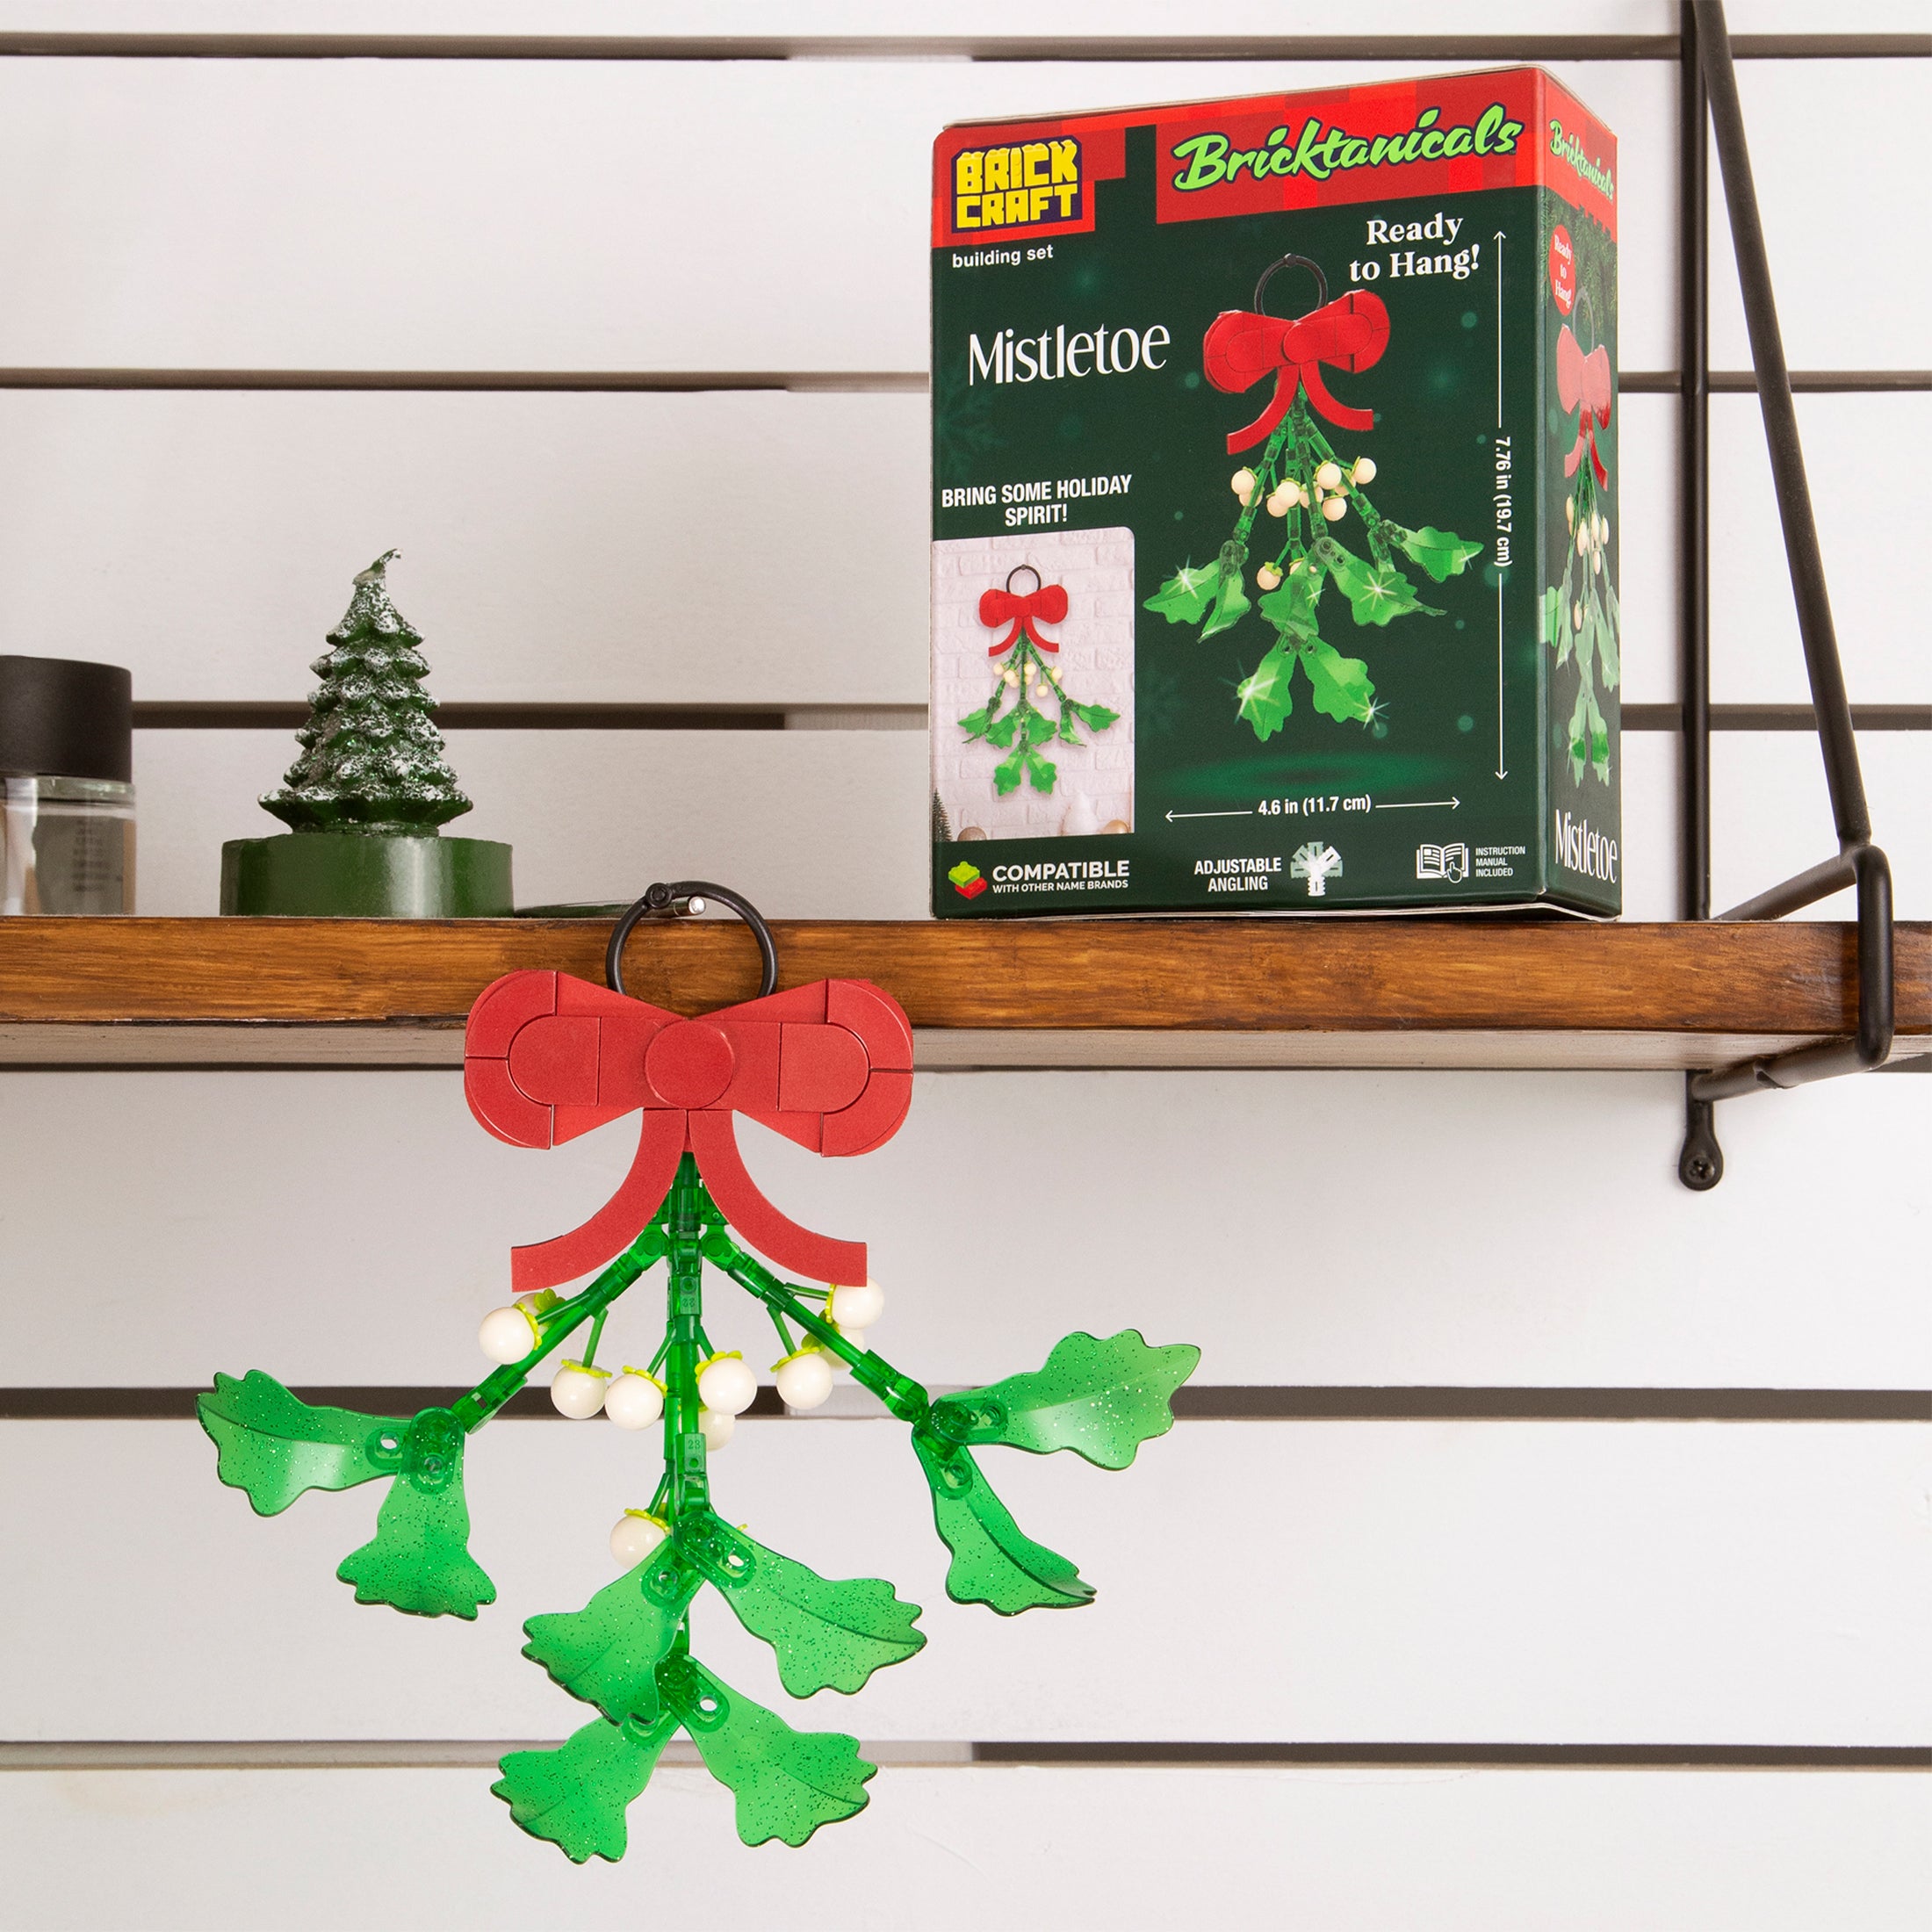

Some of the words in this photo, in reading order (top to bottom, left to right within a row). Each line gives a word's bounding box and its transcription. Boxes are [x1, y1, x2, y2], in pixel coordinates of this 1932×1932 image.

[1173, 104, 1524, 190] Bricktanicals
[1549, 119, 1615, 202] Bricktanicals
[956, 139, 1078, 195] BRICK
[956, 184, 1078, 228] CRAFT
[1366, 212, 1464, 247] Ready
[951, 249, 1021, 268] building
[1026, 243, 1054, 261] set
[1349, 256, 1381, 282] to
[1388, 244, 1481, 280] Hang!
[1554, 234, 1573, 265] Ready
[969, 323, 1171, 386] Mistletoe
[1495, 436, 1511, 472] 7.76
[941, 483, 997, 508] BRING
[1000, 479, 1053, 504] SOME
[1056, 473, 1132, 500] HOLIDAY
[1495, 473, 1510, 491] in
[1004, 503, 1068, 527] SPIRIT!
[1493, 494, 1512, 534] (19.7
[1493, 536, 1512, 567] cm)
[1258, 799, 1281, 816] 4.6
[1284, 798, 1299, 815] in
[1302, 796, 1339, 817] (11.7
[1343, 793, 1372, 813] cm)
[1475, 846, 1526, 856] INSTRUCTION
[1554, 808, 1618, 884] Mistletoe
[991, 859, 1130, 883] COMPATIBLE
[1193, 857, 1282, 876] ADJUSTABLE
[1475, 857, 1508, 867] MANUAL
[1475, 867, 1514, 877] INCLUDED
[992, 883, 1020, 894] WITH
[1020, 882, 1055, 892] OTHER
[1056, 881, 1085, 891] NAME
[1086, 879, 1128, 890] BRANDS
[1208, 875, 1268, 892] ANGLING
[688, 1438, 701, 1450] 23
